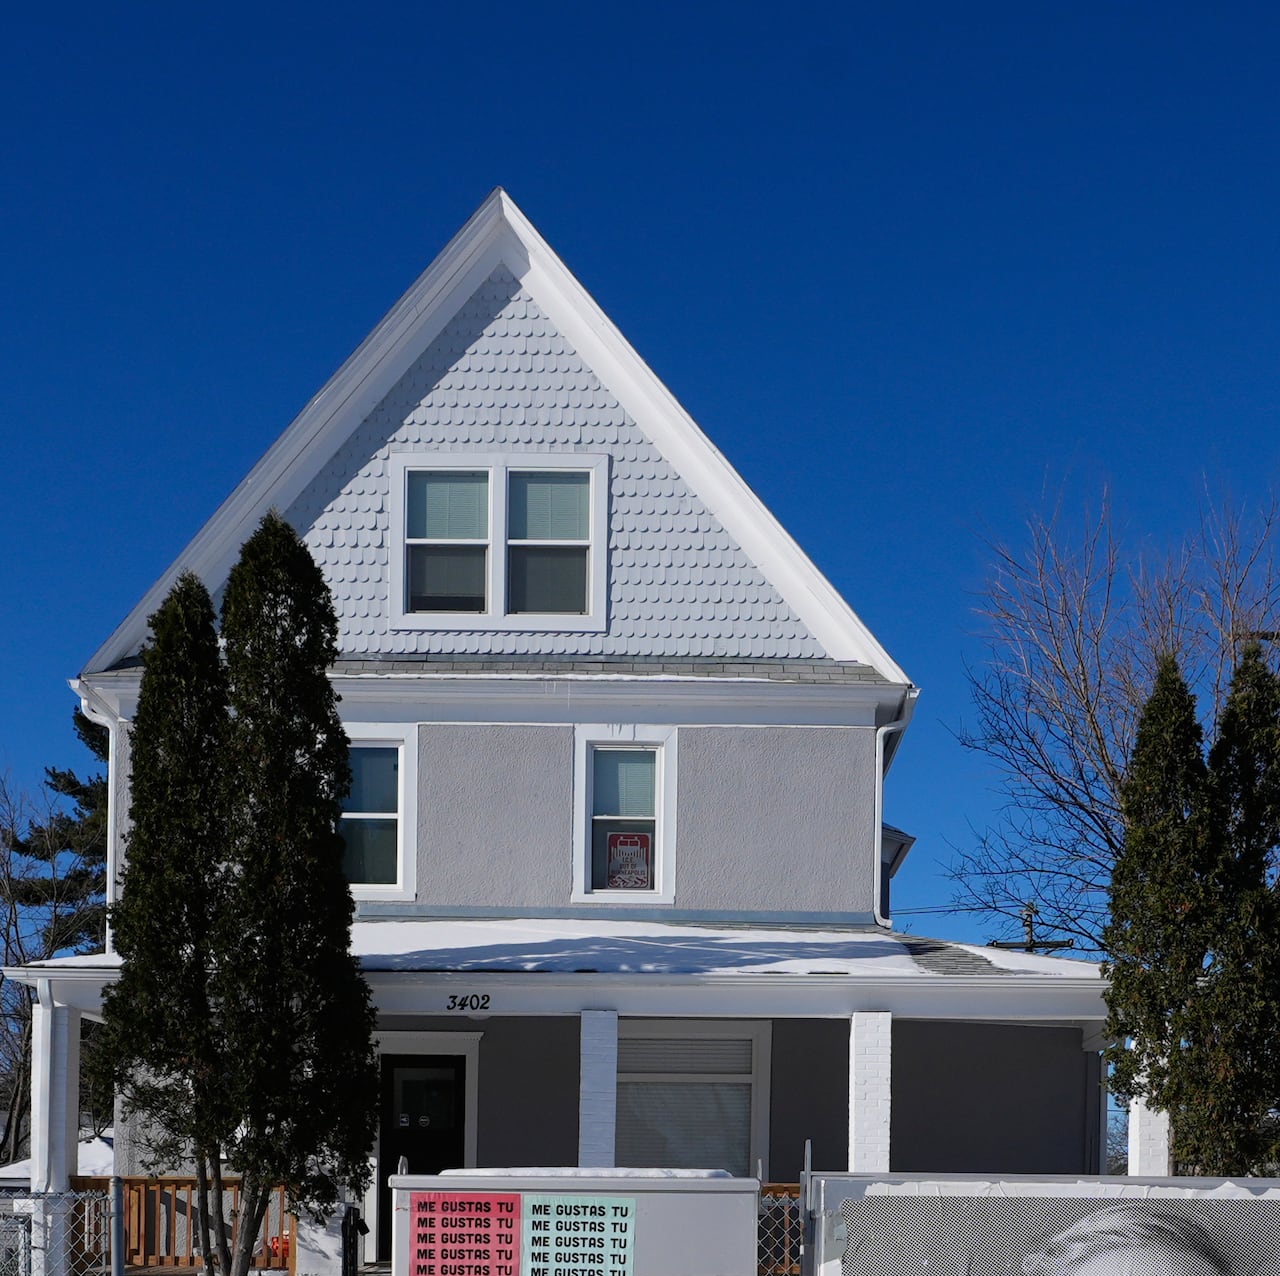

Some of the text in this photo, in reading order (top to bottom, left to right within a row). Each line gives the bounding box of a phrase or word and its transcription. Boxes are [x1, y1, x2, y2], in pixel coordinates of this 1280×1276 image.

[447, 995, 490, 1010] 3402
[418, 1202, 513, 1212] ME GUSTAS TU
[532, 1205, 628, 1217] ME GUSTAS TU
[418, 1217, 513, 1228] ME GUSTAS TU
[532, 1221, 627, 1233] ME GUSTAS TU
[418, 1233, 512, 1244] ME GUSTAS TU
[532, 1237, 626, 1248] ME GUSTAS TU
[417, 1249, 512, 1260] ME GUSTAS TU
[532, 1252, 626, 1264] ME GUSTAS TU
[417, 1265, 512, 1275] ME GUSTAS TU
